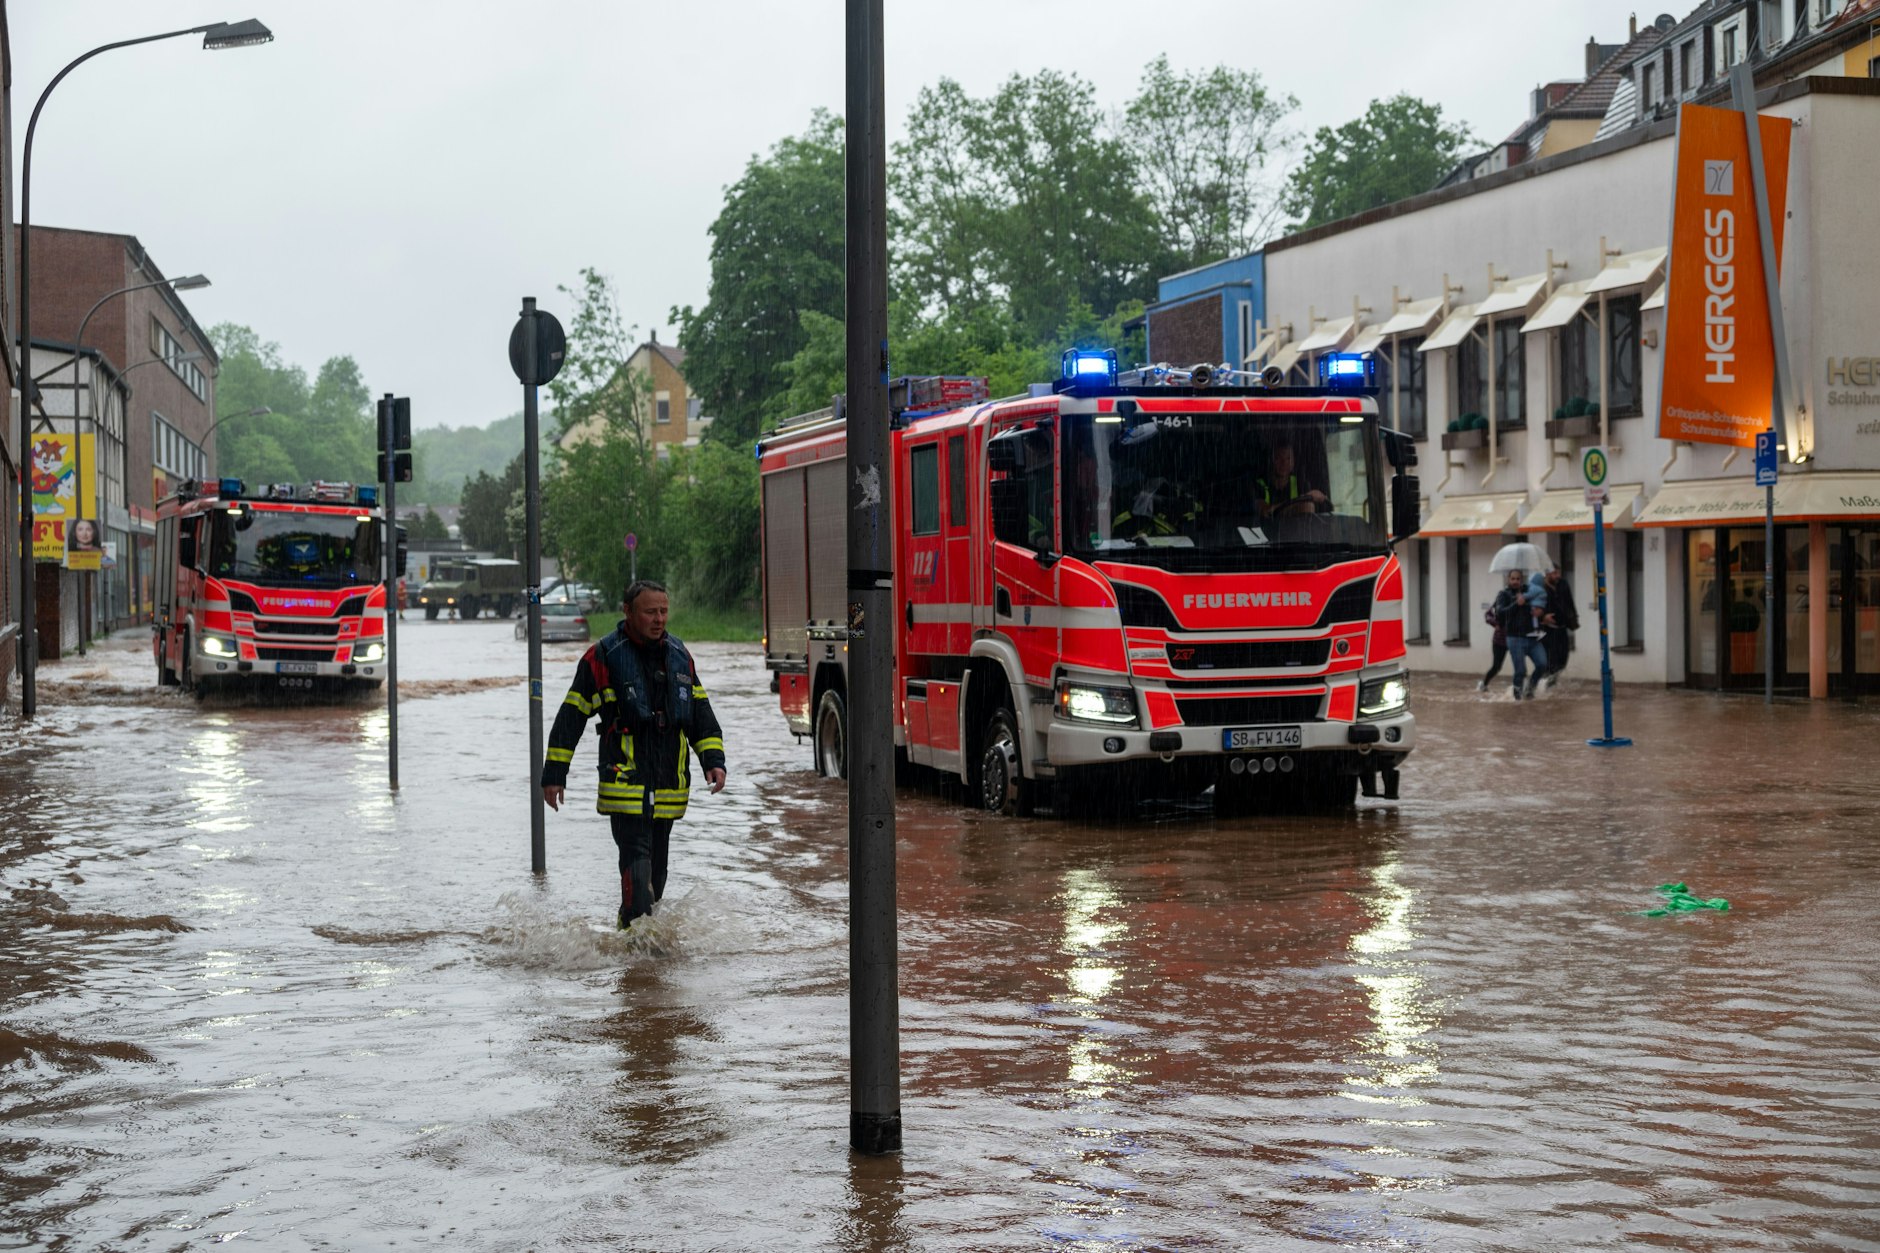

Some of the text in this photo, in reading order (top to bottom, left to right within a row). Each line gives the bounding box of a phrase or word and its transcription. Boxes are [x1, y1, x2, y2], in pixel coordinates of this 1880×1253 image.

[1704, 208, 1736, 384] HERGES
[1680, 421, 1749, 440] Schuhmanufaktur
[1758, 435, 1770, 457] P
[913, 550, 933, 576] 112
[263, 596, 332, 609] FEUERWEHR
[1183, 592, 1312, 609] FEUERWEHR
[1233, 730, 1300, 746] SB FW 146
